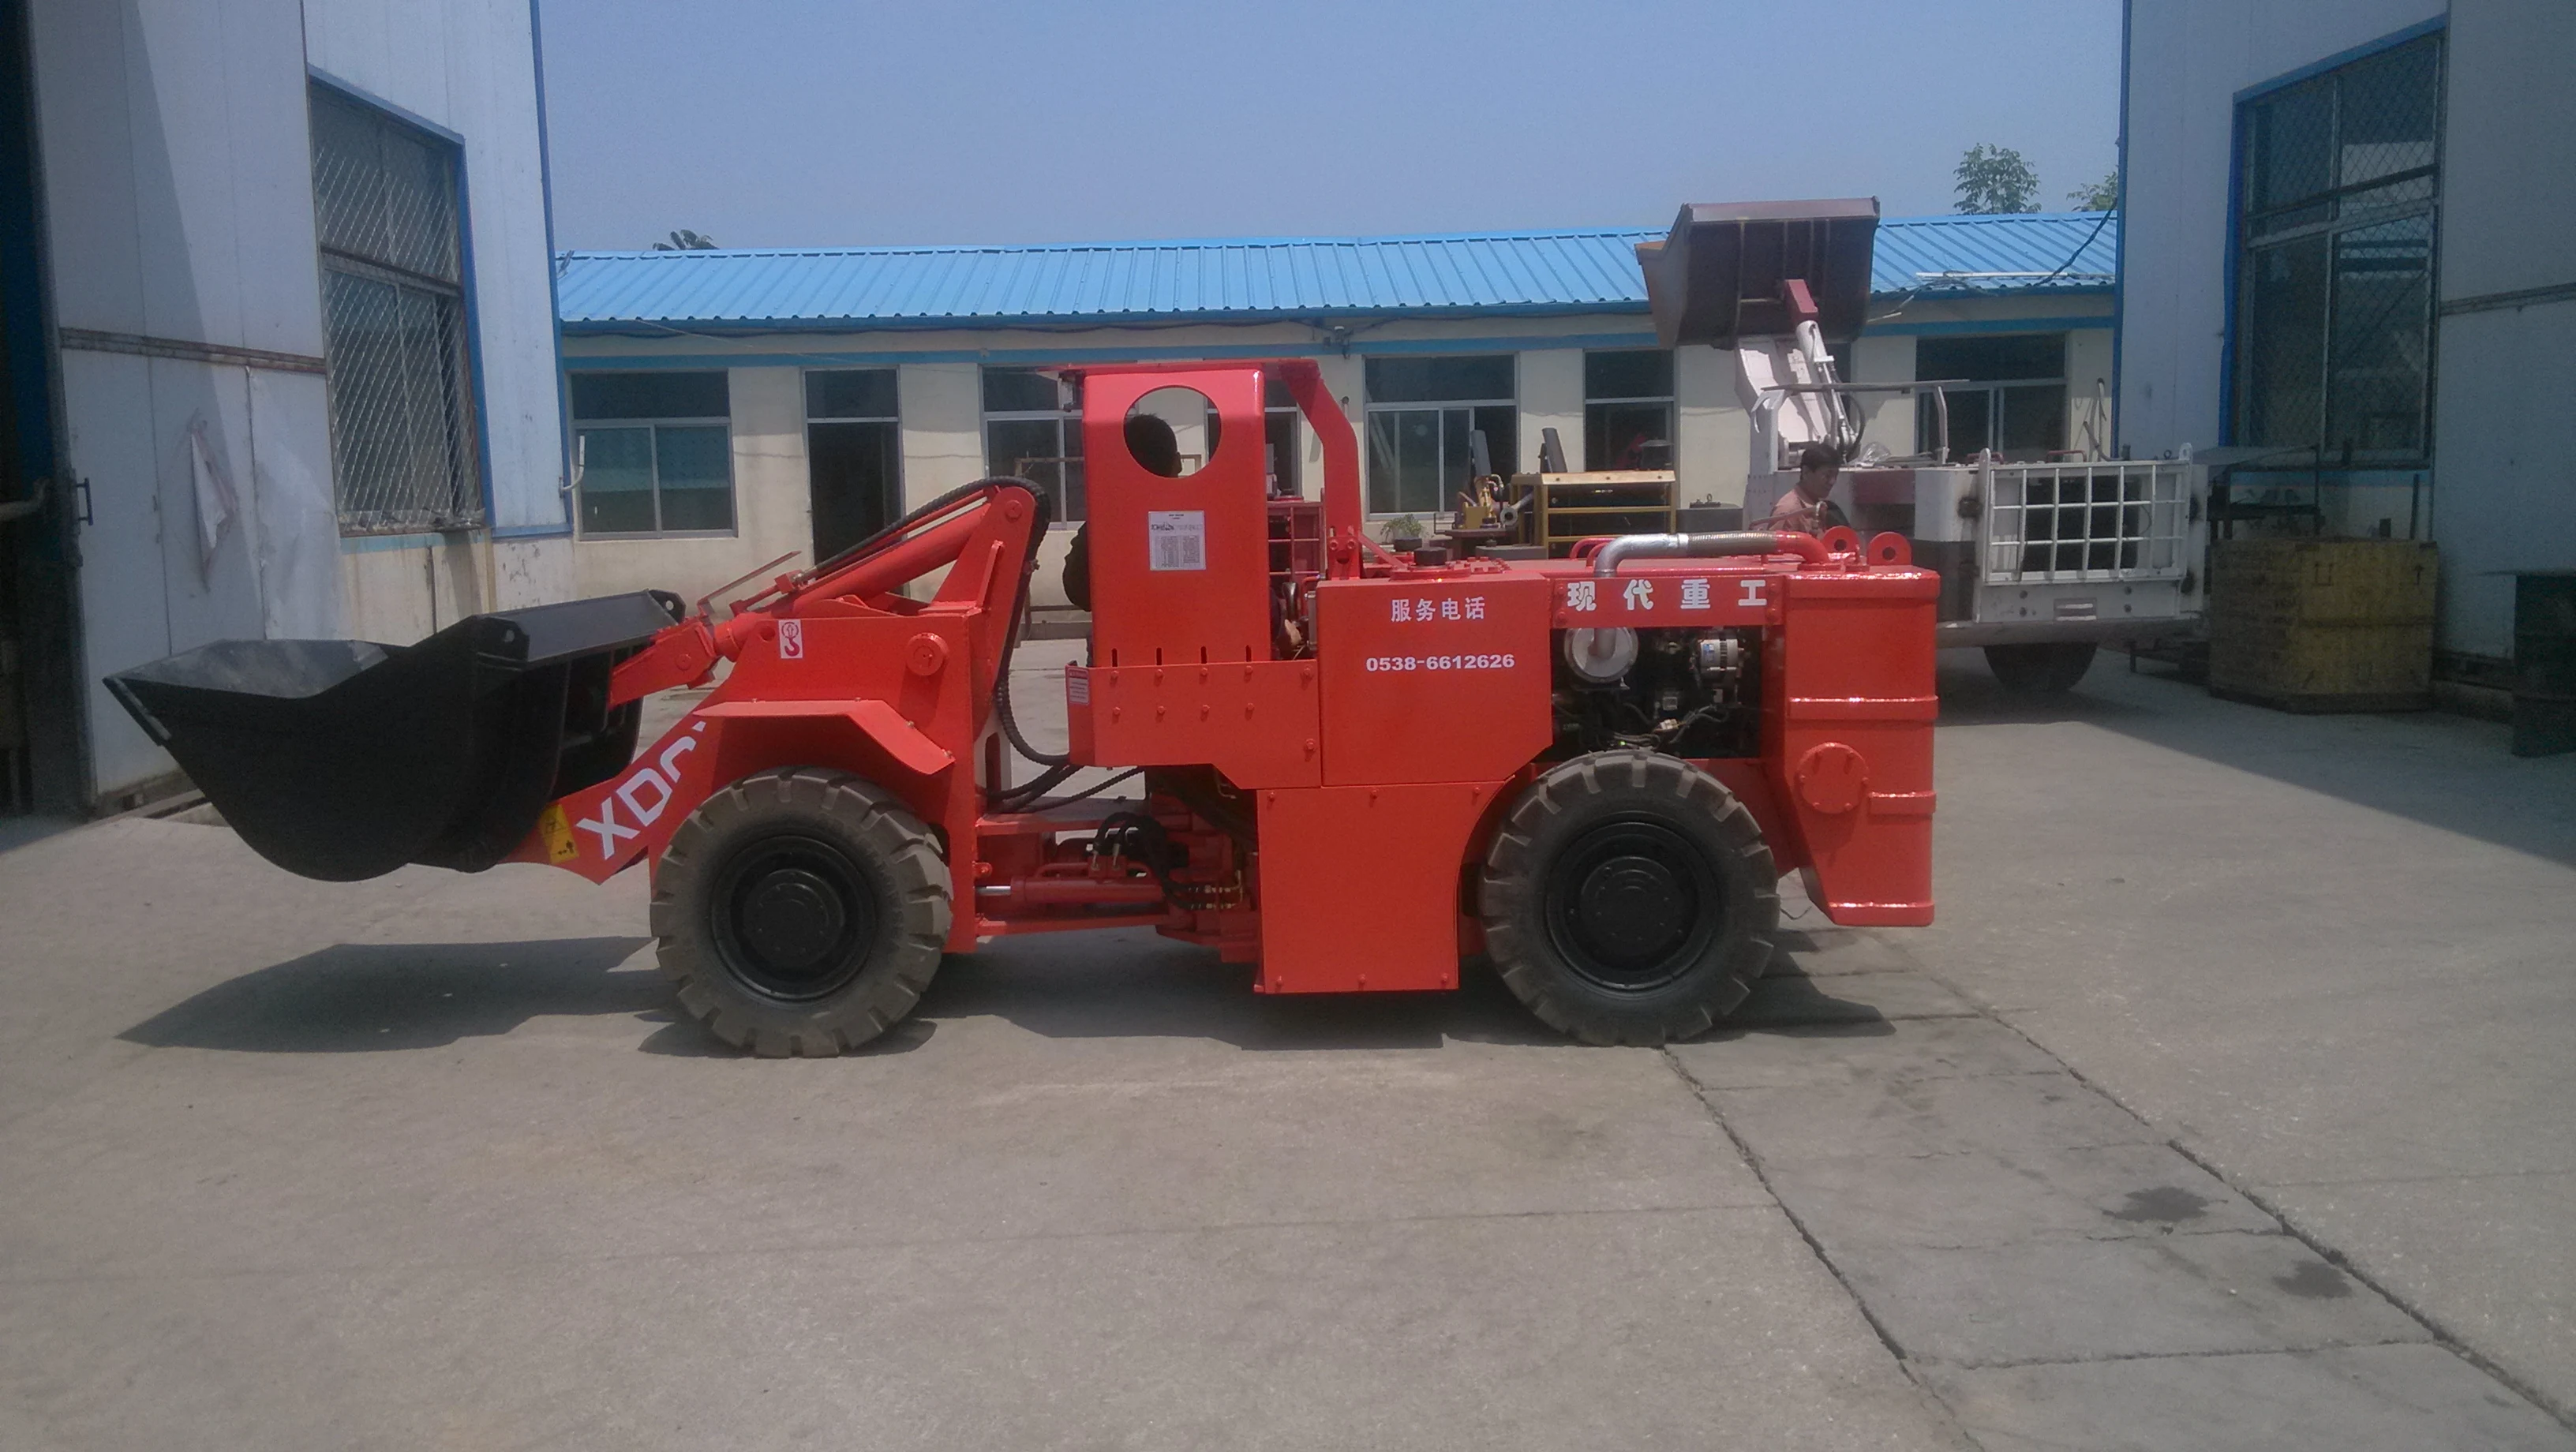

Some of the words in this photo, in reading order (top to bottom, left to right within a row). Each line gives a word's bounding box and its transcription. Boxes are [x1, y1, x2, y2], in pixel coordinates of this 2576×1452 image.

[1567, 578, 1768, 612] 现代重工
[1391, 597, 1485, 622] 服务电话
[1365, 654, 1515, 672] 0538-6612626
